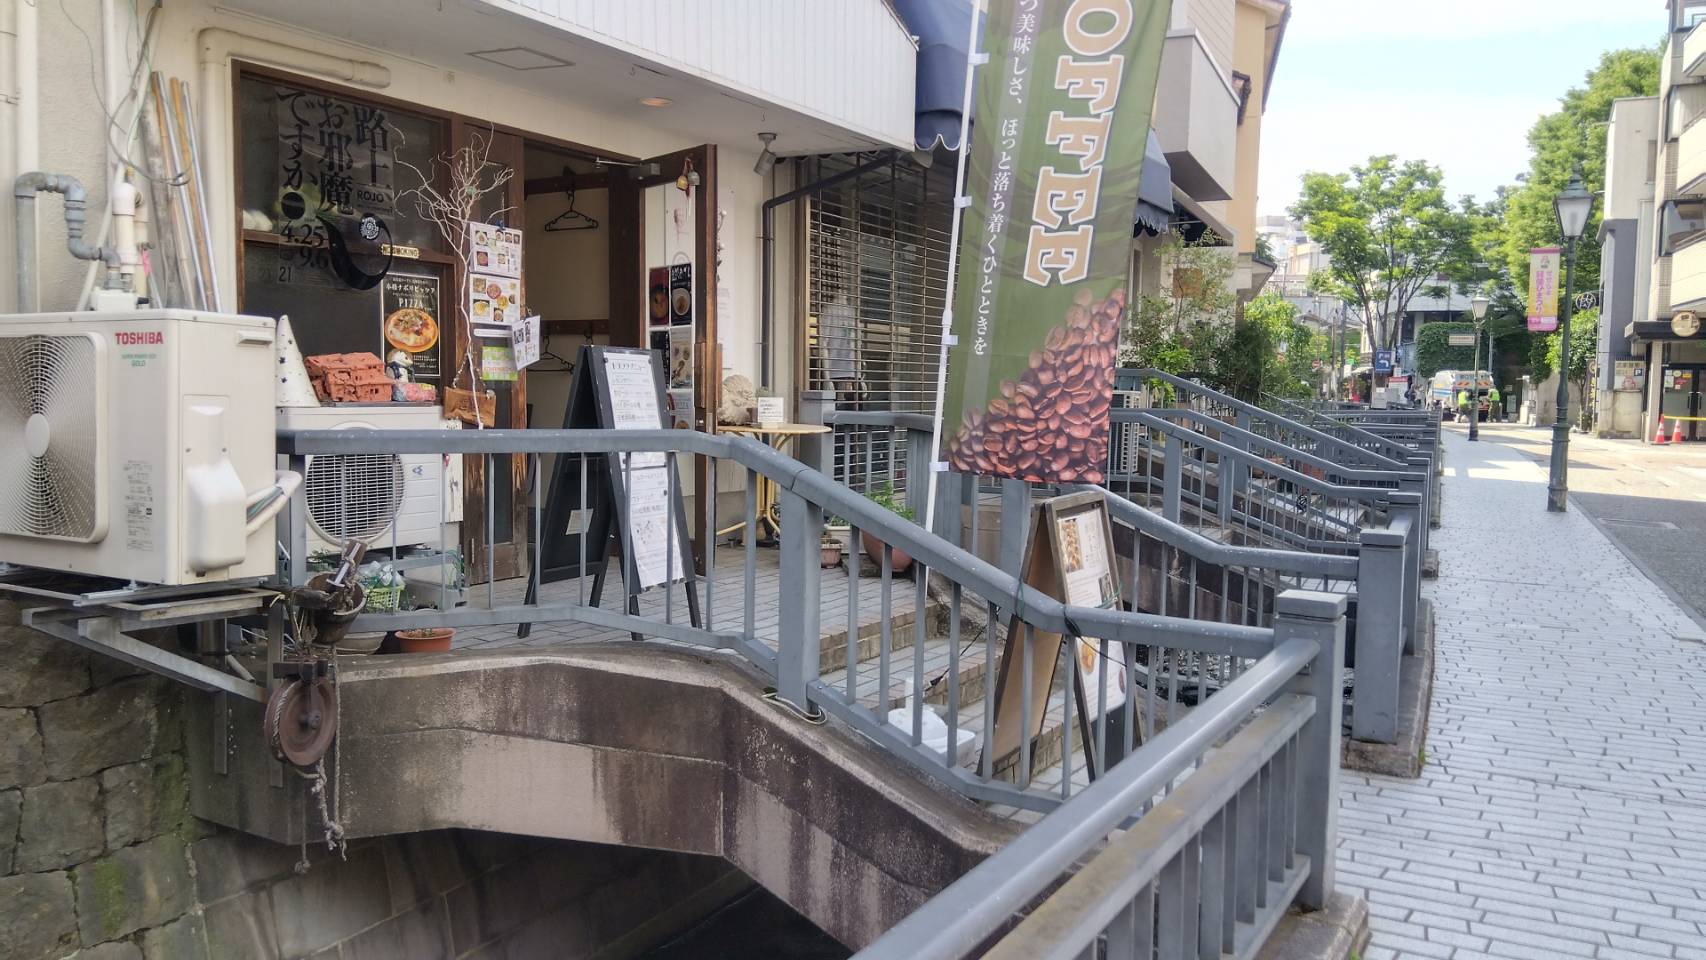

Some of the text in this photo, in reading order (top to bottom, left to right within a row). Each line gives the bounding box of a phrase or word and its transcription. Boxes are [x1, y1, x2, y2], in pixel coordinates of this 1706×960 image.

[276, 91, 318, 191] ですか
[318, 98, 354, 216] お邪魔
[357, 190, 385, 203] ROJO
[398, 297, 424, 309] PIZZA
[115, 331, 164, 345] TOSHIBA
